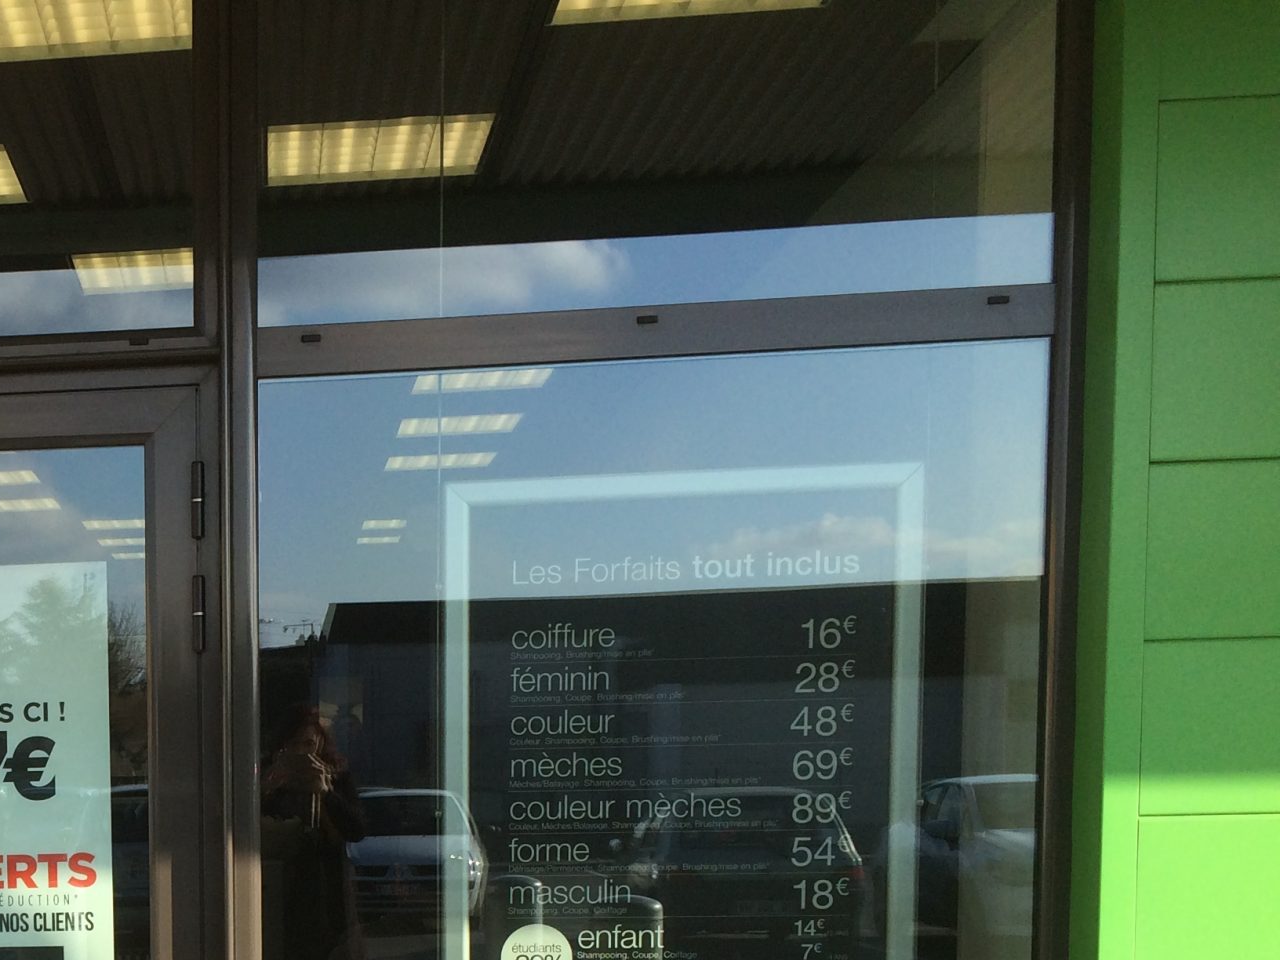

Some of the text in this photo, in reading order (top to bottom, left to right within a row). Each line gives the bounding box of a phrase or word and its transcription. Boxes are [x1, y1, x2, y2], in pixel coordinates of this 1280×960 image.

[512, 550, 861, 585] Les Forfaits tout inclus
[511, 615, 857, 650] coiffure 16€
[510, 659, 856, 694] féminin 28€
[23, 702, 49, 722] CI
[510, 703, 855, 737] couleur 48€
[510, 747, 854, 780] mèches 69€
[509, 790, 853, 824] couleur mèches 89€
[508, 838, 590, 862] forme
[509, 877, 850, 911] masculin 18€
[0, 912, 29, 932] NOS
[33, 911, 95, 932] CLIENTS
[578, 918, 826, 949] enfant 14€
[511, 943, 562, 953] étudiants
